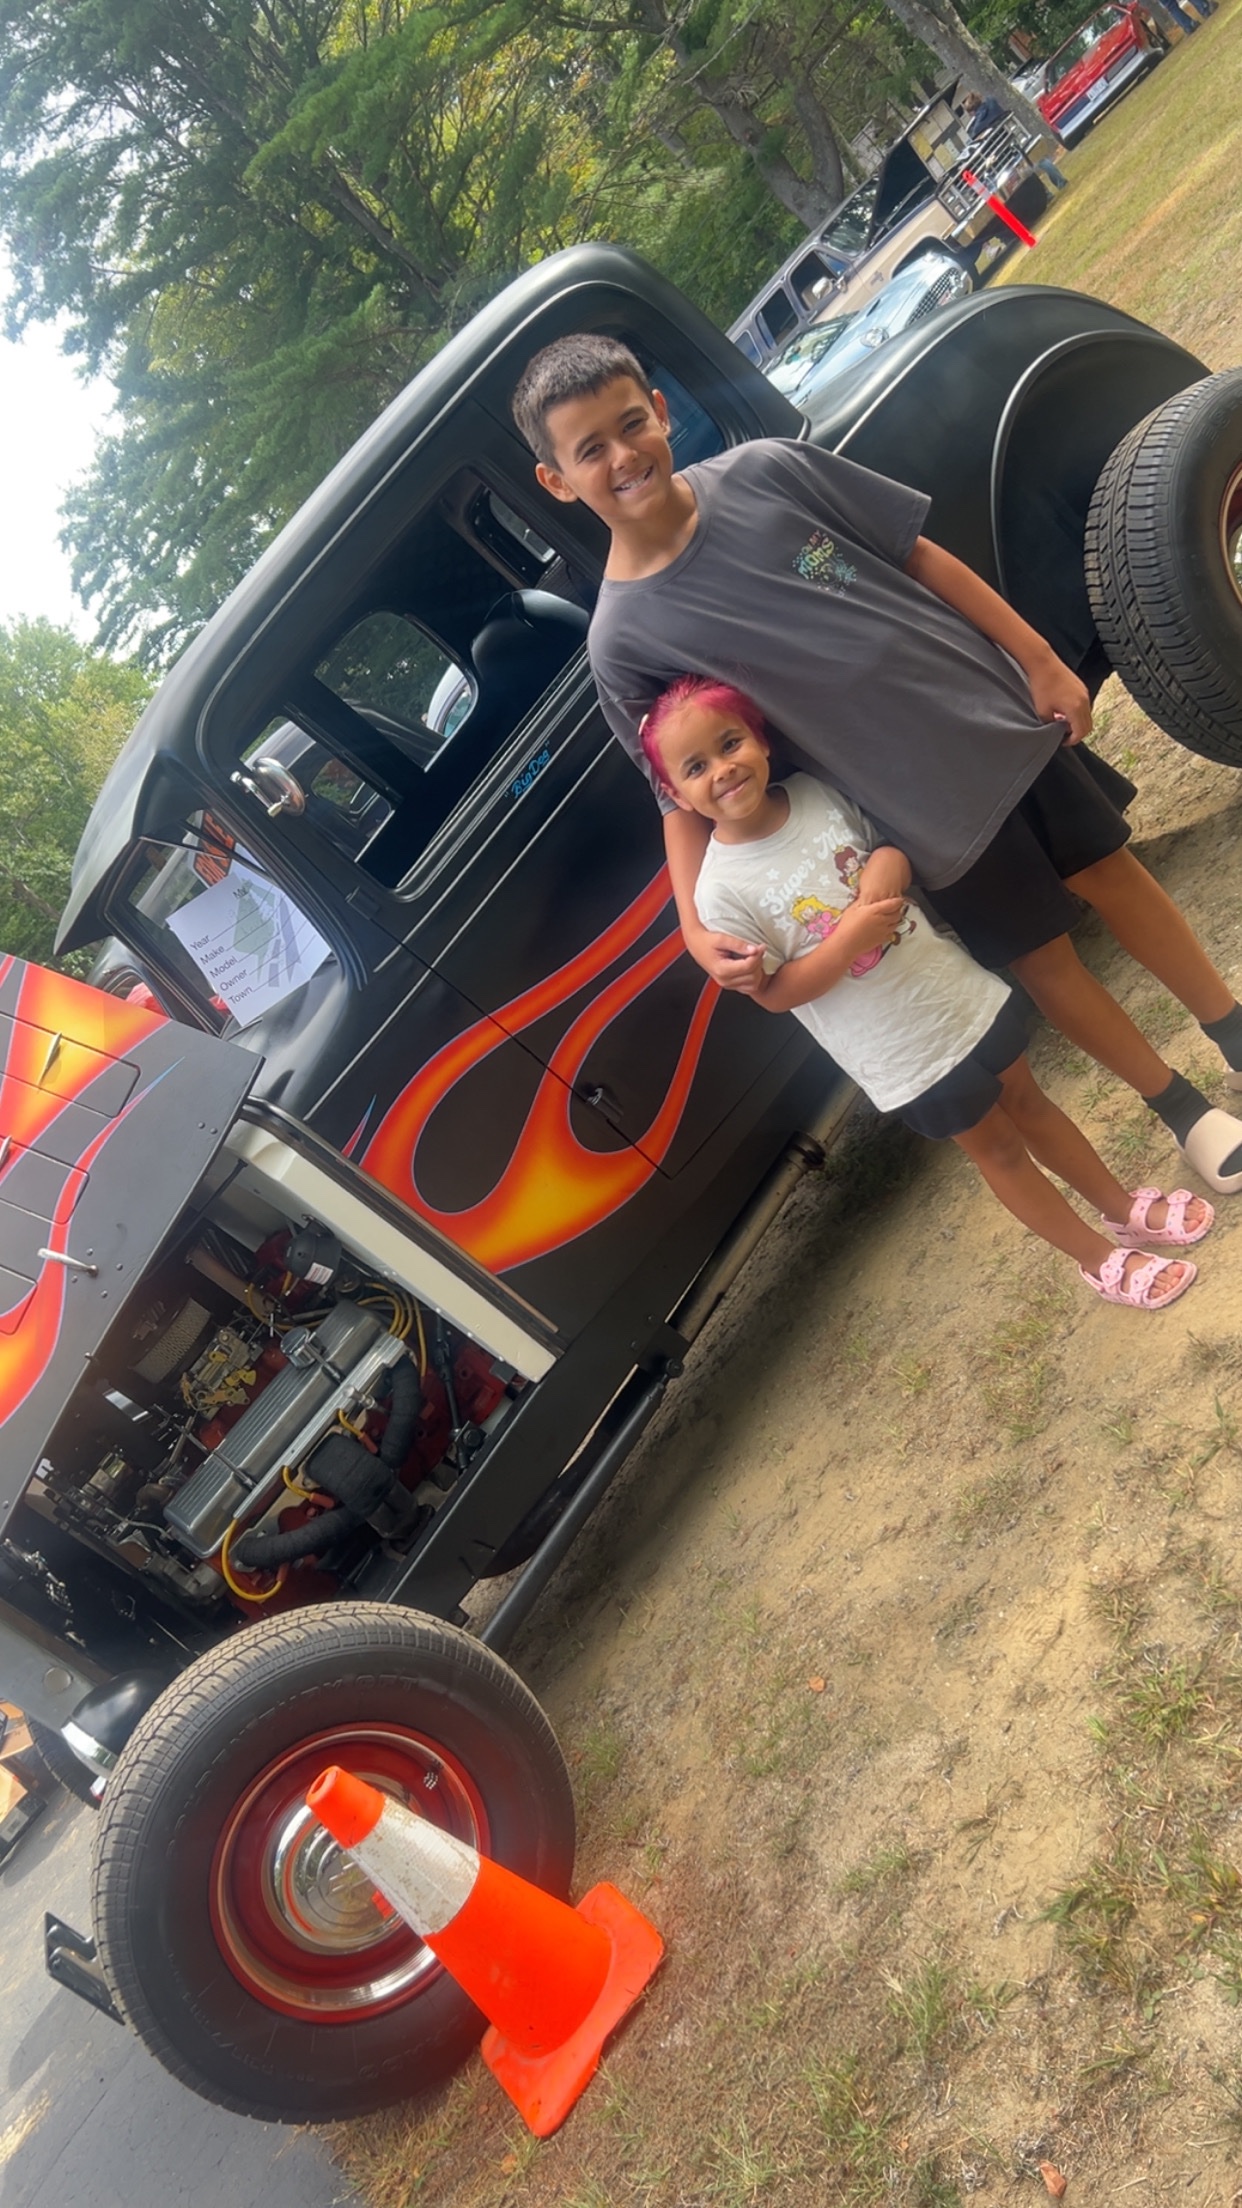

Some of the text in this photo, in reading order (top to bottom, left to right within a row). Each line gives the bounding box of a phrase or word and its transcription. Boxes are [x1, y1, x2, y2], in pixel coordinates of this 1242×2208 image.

[798, 536, 835, 580] MOMS
[759, 858, 816, 914] Super
[189, 934, 211, 952] Year
[199, 945, 226, 965] Make
[209, 956, 238, 979] Model
[219, 968, 249, 991] Owner
[228, 986, 253, 1005] Town
